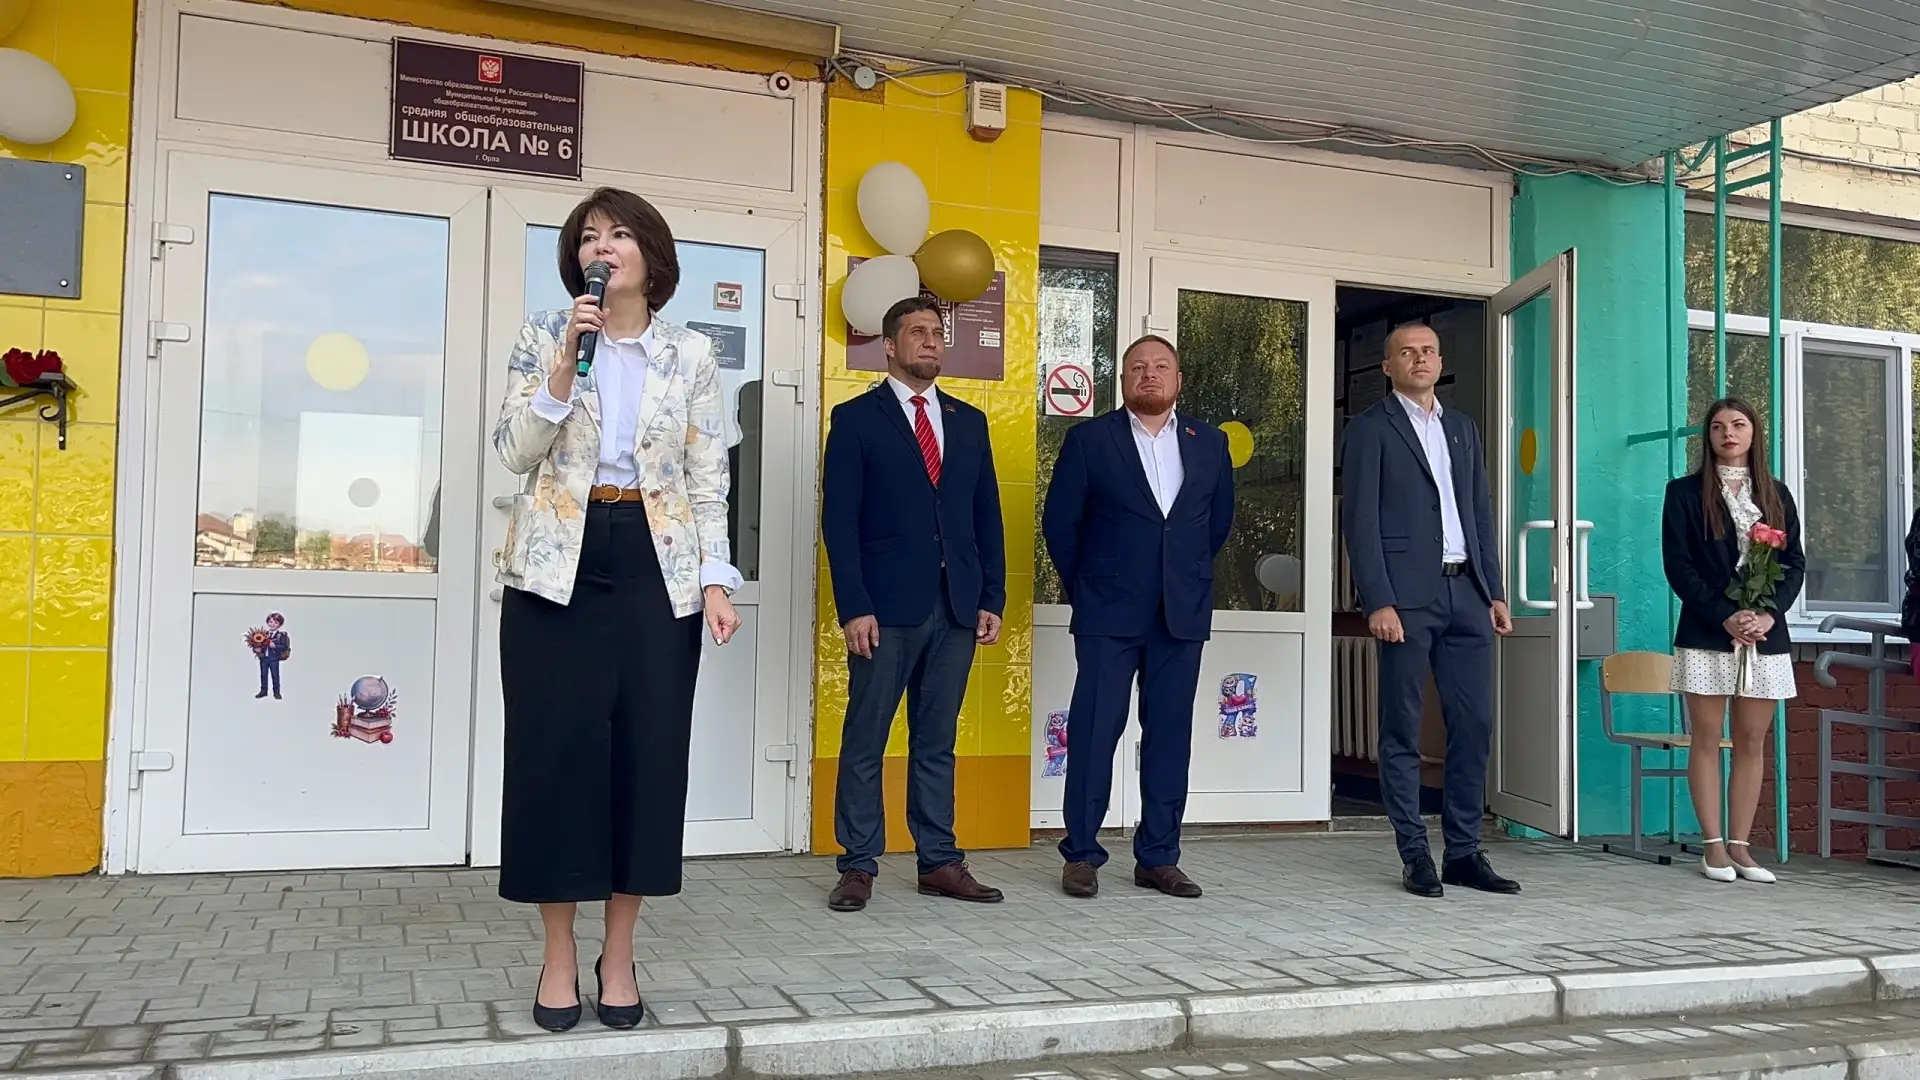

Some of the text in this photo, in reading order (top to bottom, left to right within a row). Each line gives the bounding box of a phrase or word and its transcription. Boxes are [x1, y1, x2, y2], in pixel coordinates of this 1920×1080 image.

[400, 74, 443, 86] Министерство
[444, 79, 483, 92] образования
[489, 87, 507, 96] науки
[508, 88, 543, 100] Российской
[543, 92, 576, 104] Федерации
[446, 90, 528, 107] Муниципальное бюджетное
[433, 97, 501, 112] общеобразовательное
[402, 106, 574, 135] средняя общеобразовательная
[402, 119, 573, 160] ШКОЛА № 6
[482, 154, 500, 163] Орла
